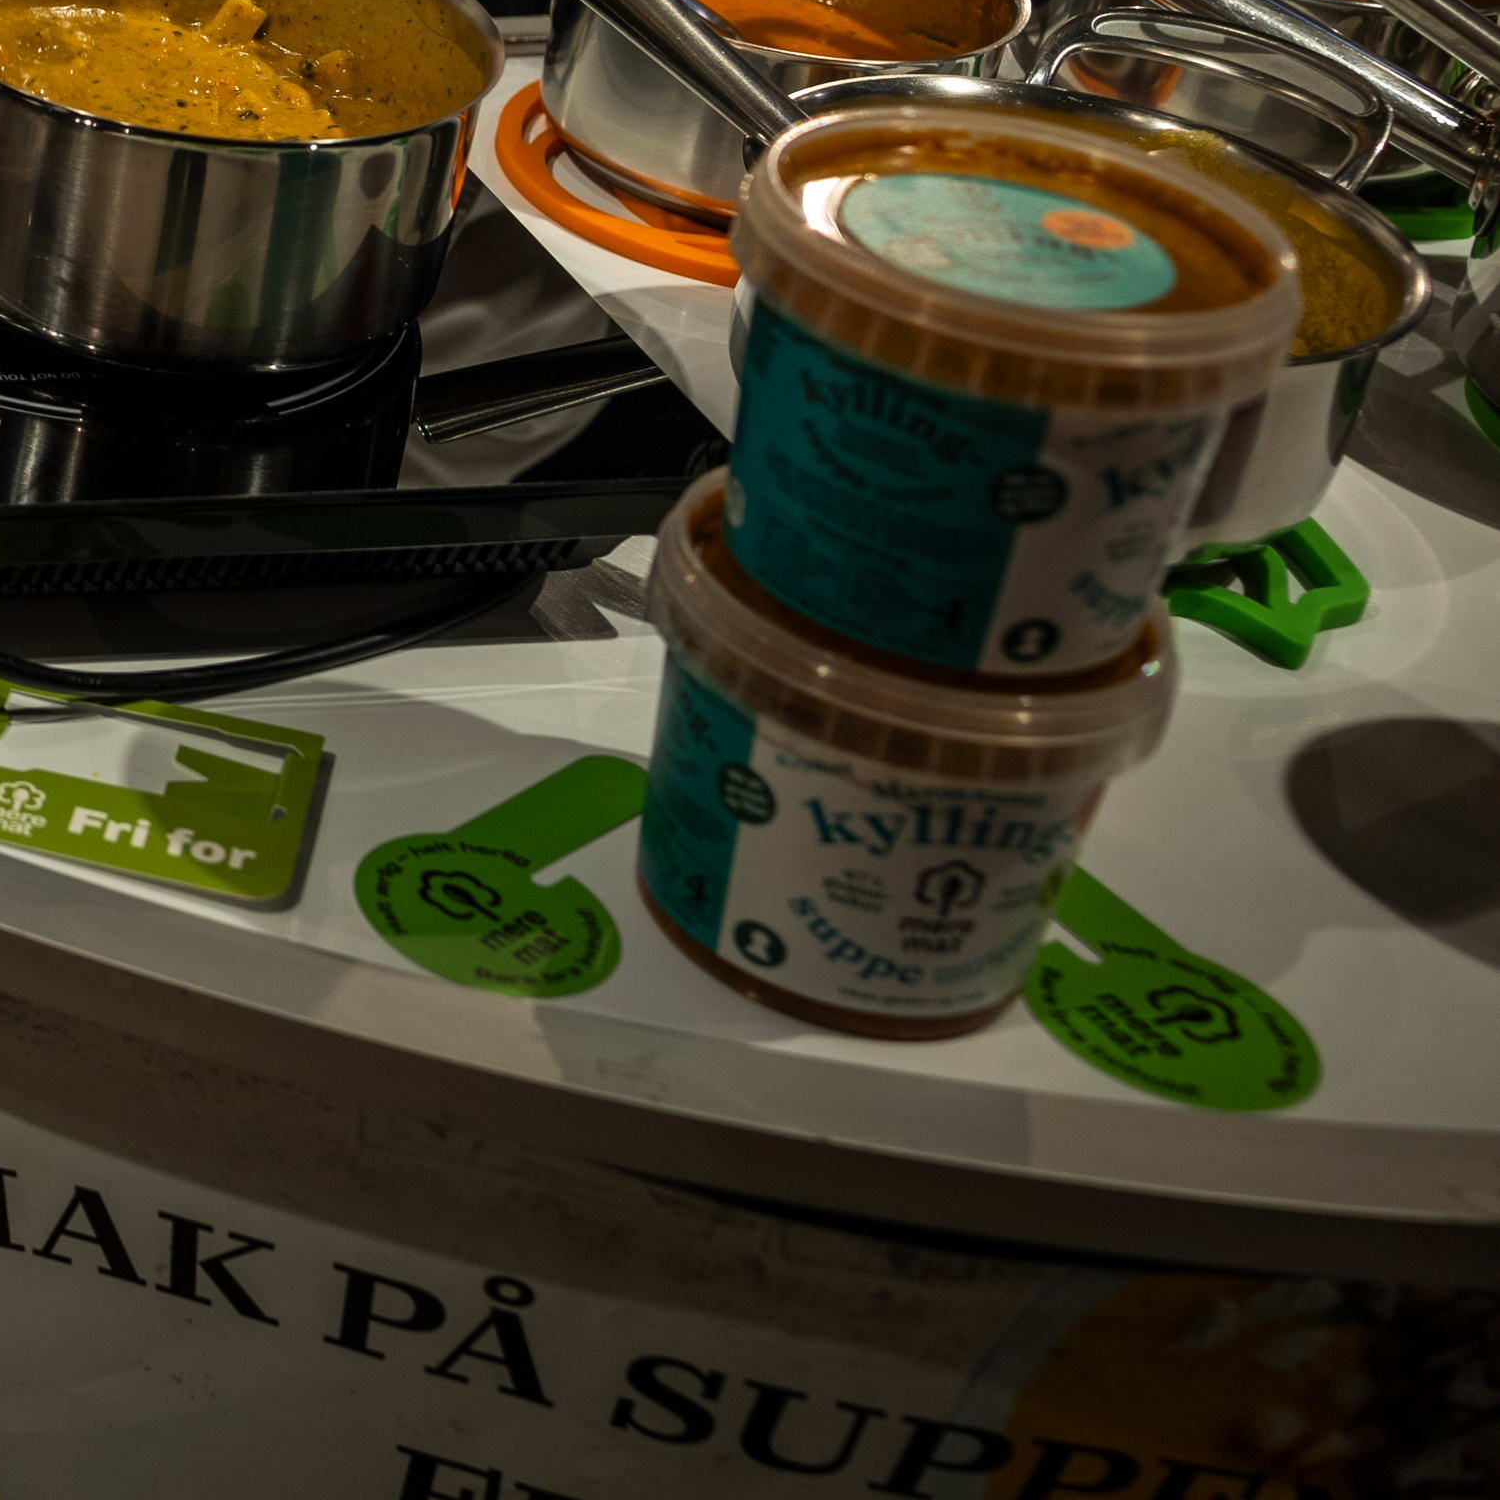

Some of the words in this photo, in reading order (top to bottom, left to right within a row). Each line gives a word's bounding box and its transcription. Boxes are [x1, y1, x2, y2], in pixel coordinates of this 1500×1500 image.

[29, 372, 58, 384] NOT
[59, 372, 82, 382] DO
[67, 807, 152, 851] Fri
[164, 825, 258, 871] for
[480, 910, 547, 951] mere
[513, 929, 570, 966] mat
[323, 1272, 555, 1410] PÅ
[611, 1351, 1335, 1500] SUPP
